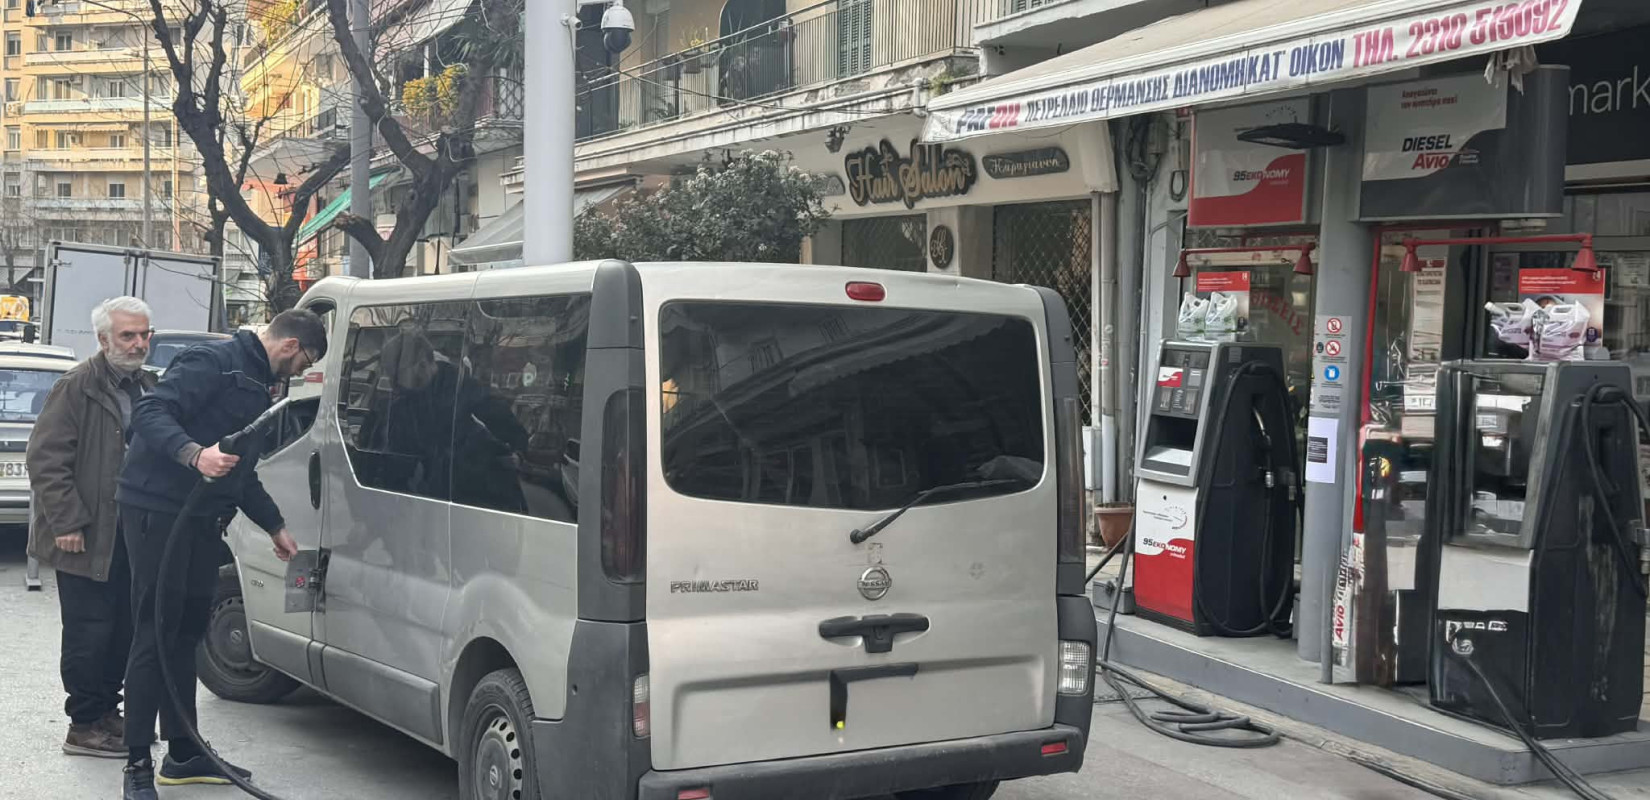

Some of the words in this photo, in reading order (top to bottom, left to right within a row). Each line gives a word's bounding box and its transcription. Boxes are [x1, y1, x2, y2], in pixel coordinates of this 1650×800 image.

[1025, 89, 1088, 122] ΠΕΤΡΕΛΑΙΟ
[1091, 74, 1170, 112] ΘΕΡΜΑΝΣΗΣ
[1173, 57, 1246, 97] ΔΙΑΝΟΜΗ
[1289, 38, 1346, 77] ΟΙΚΟΝ
[1353, 26, 1398, 68] ΤΗΛ.
[1406, 13, 1467, 58] 2310
[1402, 134, 1453, 152] DIESEL
[848, 140, 898, 202] Hair
[900, 136, 971, 207] Salon
[670, 579, 759, 594] PRIMASTAR
